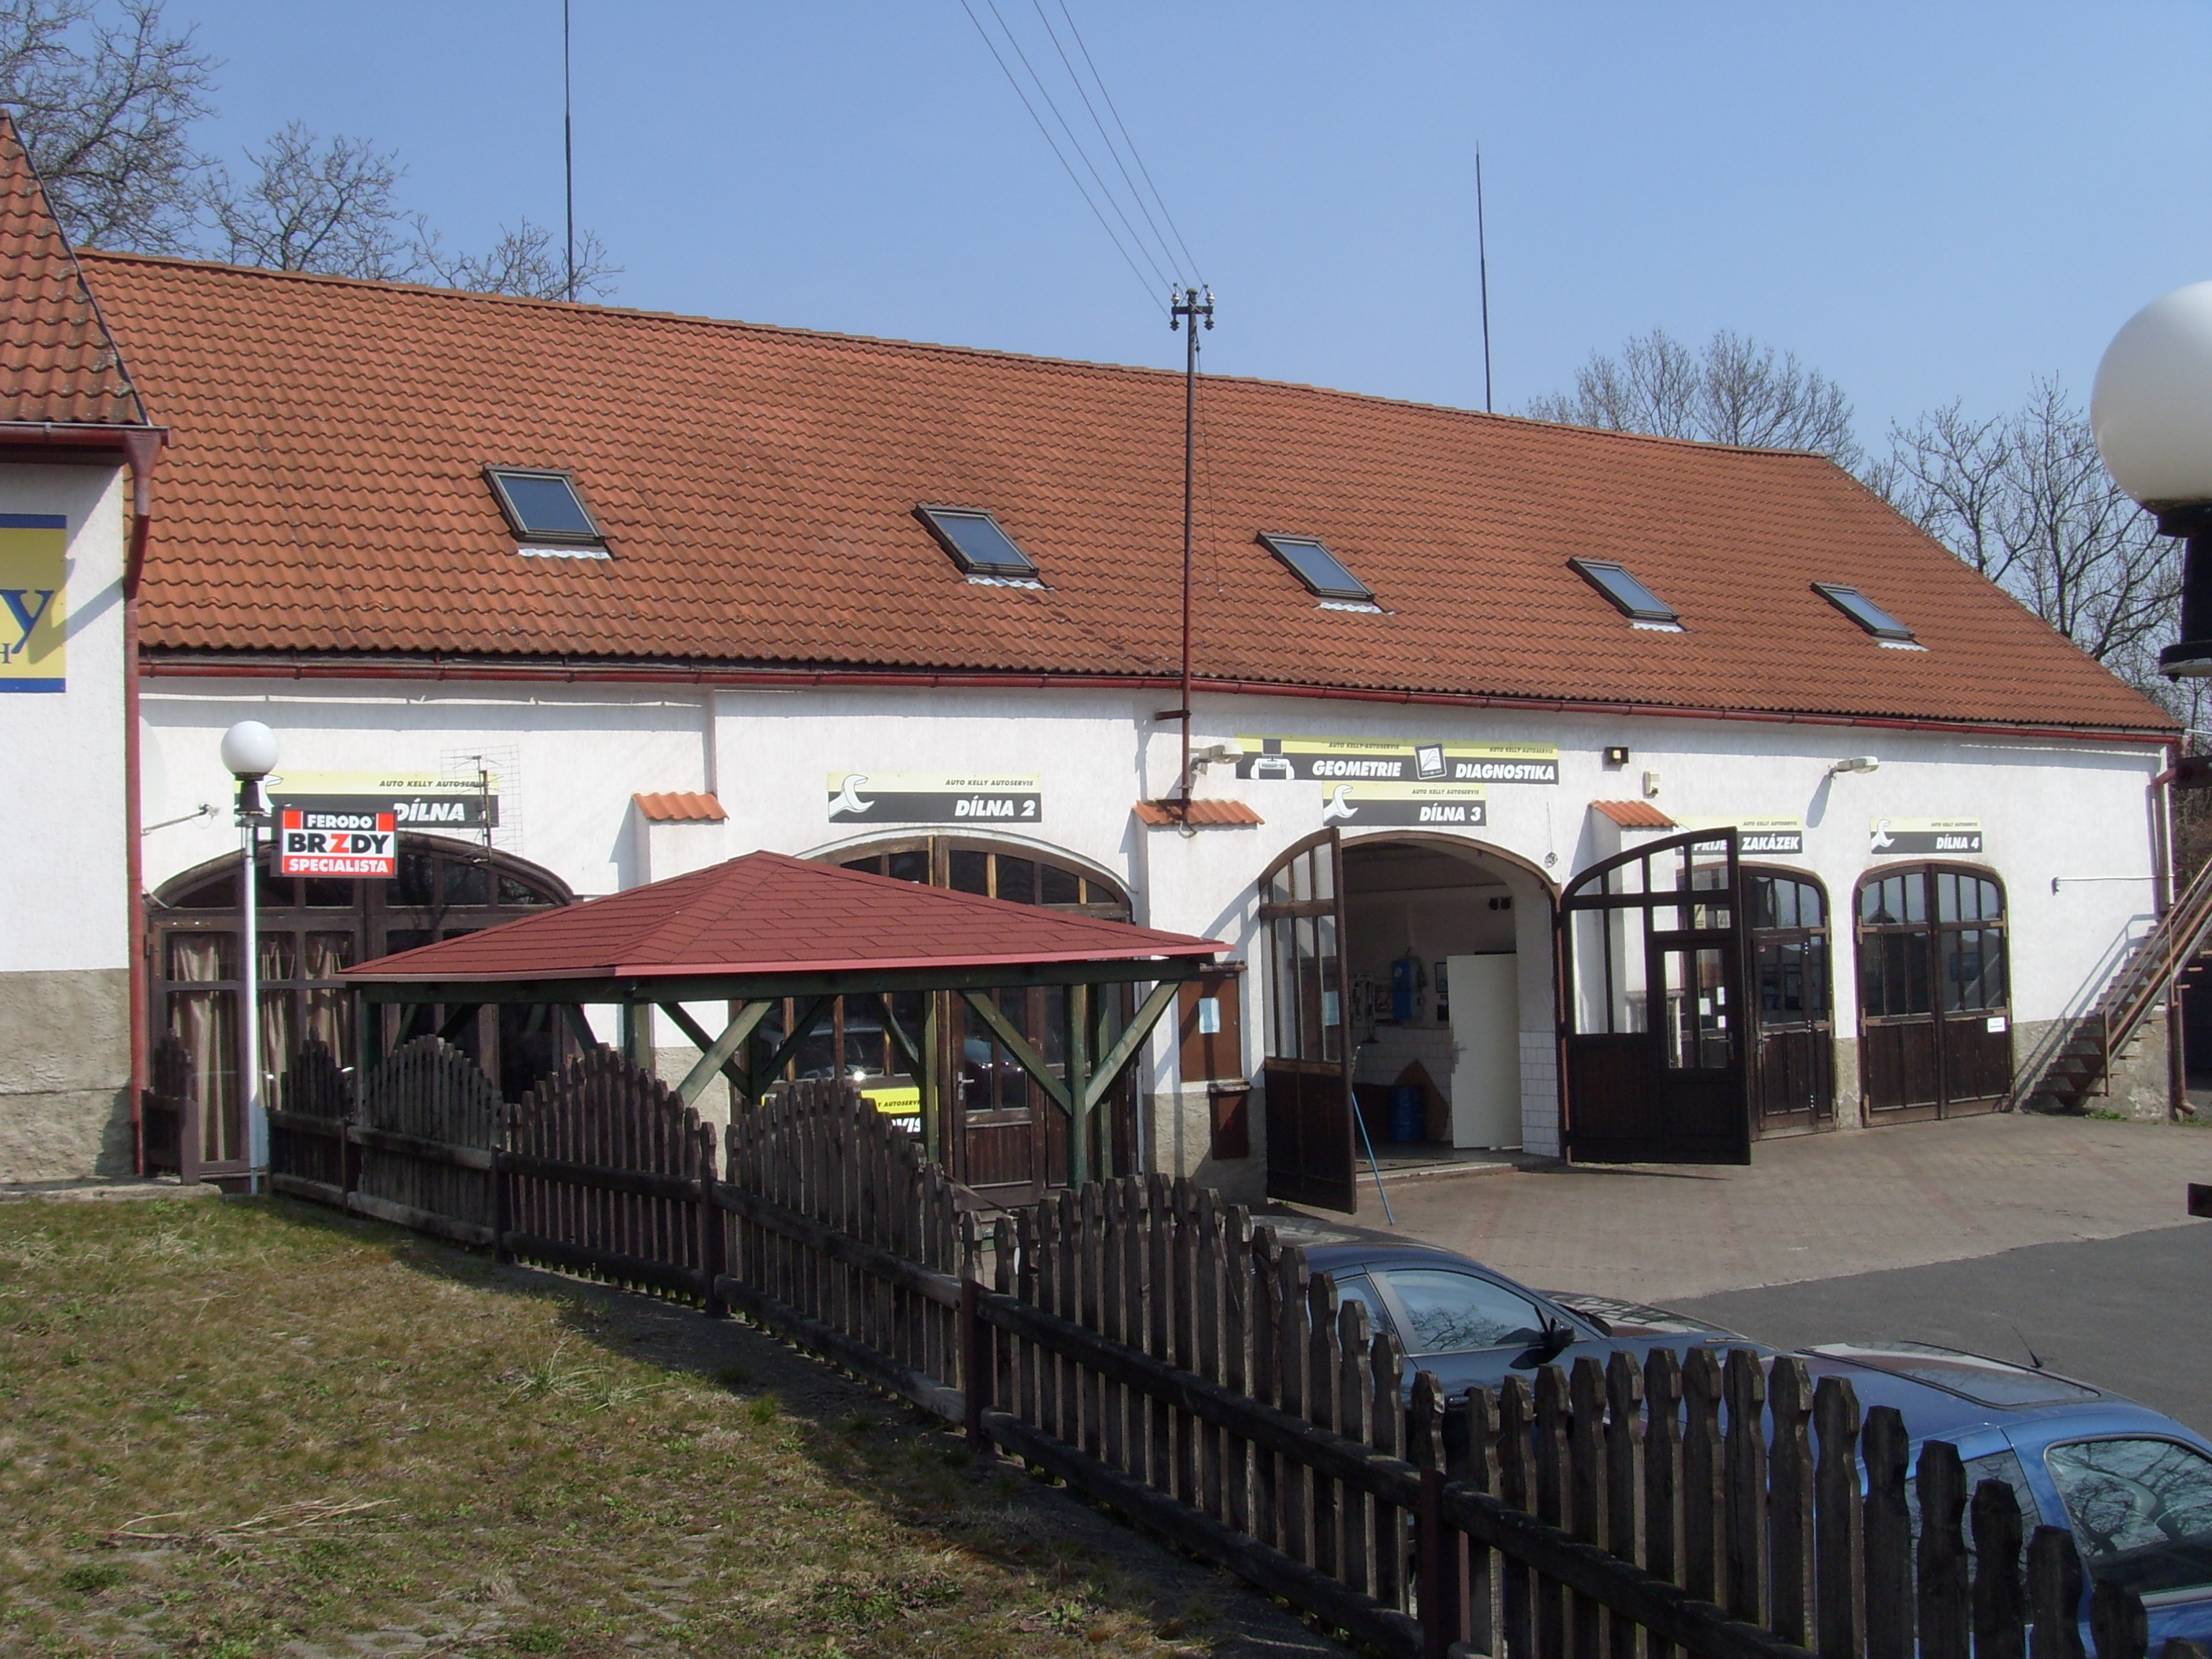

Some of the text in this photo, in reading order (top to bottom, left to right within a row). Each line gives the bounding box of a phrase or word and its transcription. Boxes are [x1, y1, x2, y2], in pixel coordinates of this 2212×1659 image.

[1312, 760, 1402, 777] GEOMETRIE
[1455, 763, 1555, 780] DIAGNOSTIKA
[393, 798, 465, 822] DÍLNA
[954, 795, 1035, 817] DÍLNA 2
[1419, 802, 1481, 822] DÍLNA 3
[307, 814, 372, 829] FERODO
[288, 832, 390, 854] BRZDY
[1741, 833, 1799, 850] ZAKÁZEK
[1936, 833, 1979, 849] DÍLNA 4
[289, 858, 388, 873] SPECIALISTA
